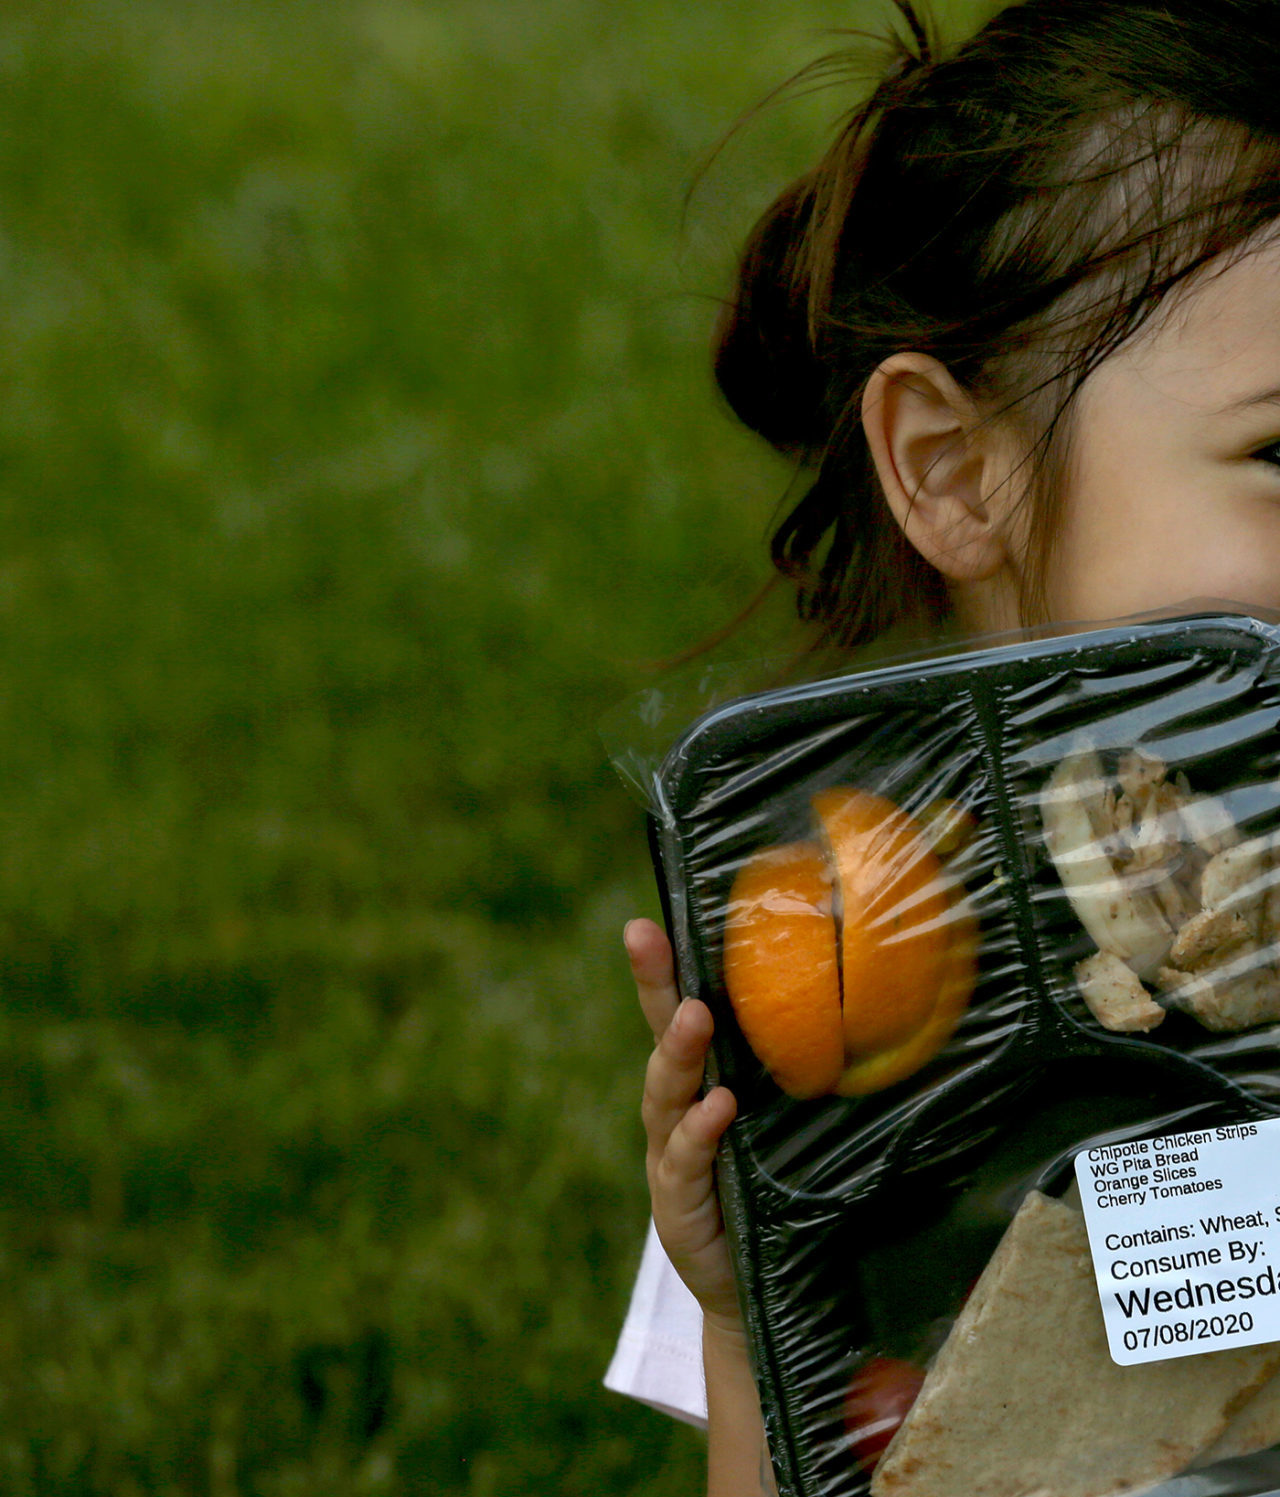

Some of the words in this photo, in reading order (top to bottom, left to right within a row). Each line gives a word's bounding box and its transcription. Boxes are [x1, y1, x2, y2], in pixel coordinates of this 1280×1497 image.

[1088, 1142, 1148, 1162] Chipotle
[1153, 1132, 1212, 1150] Chicken
[1215, 1123, 1258, 1141] Strips
[1091, 1162, 1119, 1177] WG
[1123, 1156, 1152, 1172] Pita
[1156, 1148, 1199, 1167] Bread
[1094, 1175, 1149, 1193] Orange
[1153, 1165, 1197, 1182] Slices
[1097, 1190, 1146, 1208] Cherry
[1150, 1178, 1223, 1199] Tomatoes
[1105, 1224, 1195, 1250] Contains:
[1200, 1210, 1269, 1235] Wheat,
[1110, 1247, 1222, 1280] Consume
[1228, 1240, 1266, 1263] By:
[1123, 1312, 1253, 1350] 07/08/2020
